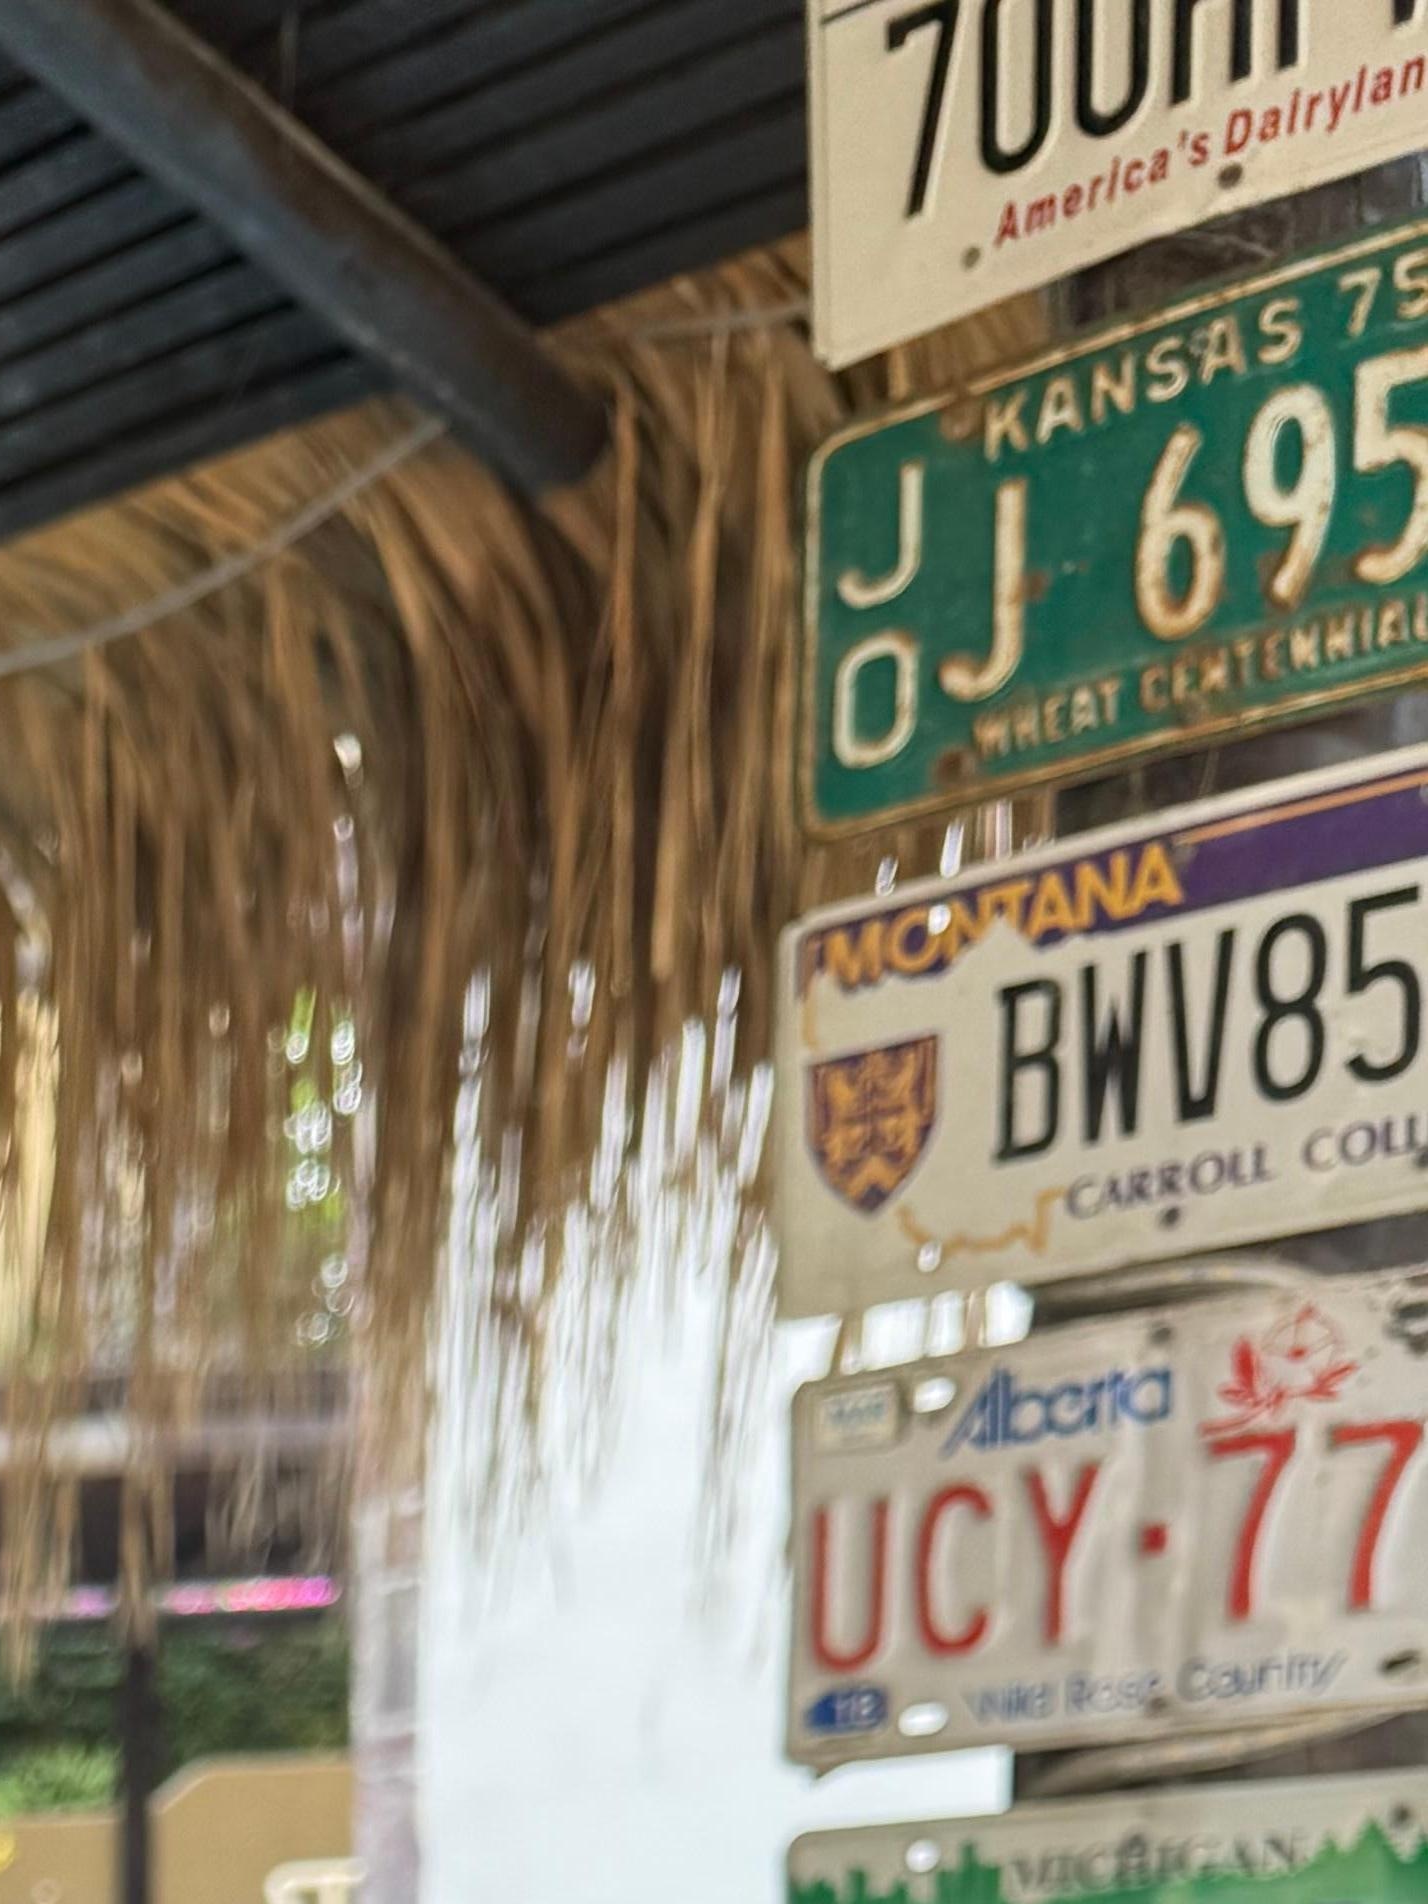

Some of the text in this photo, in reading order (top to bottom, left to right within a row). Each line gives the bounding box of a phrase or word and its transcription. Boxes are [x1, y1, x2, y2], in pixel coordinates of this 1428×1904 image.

[994, 52, 1428, 249] America's Dairylan
[983, 298, 1305, 464] KANSAS
[973, 677, 1122, 760] WHEAT
[821, 843, 1186, 990] MONTANA
[992, 885, 1421, 1166] BWV85
[1066, 1142, 1276, 1221] CARROLL
[940, 1366, 1174, 1462] Alberta
[1006, 1833, 1312, 1890] MICHIGAN
